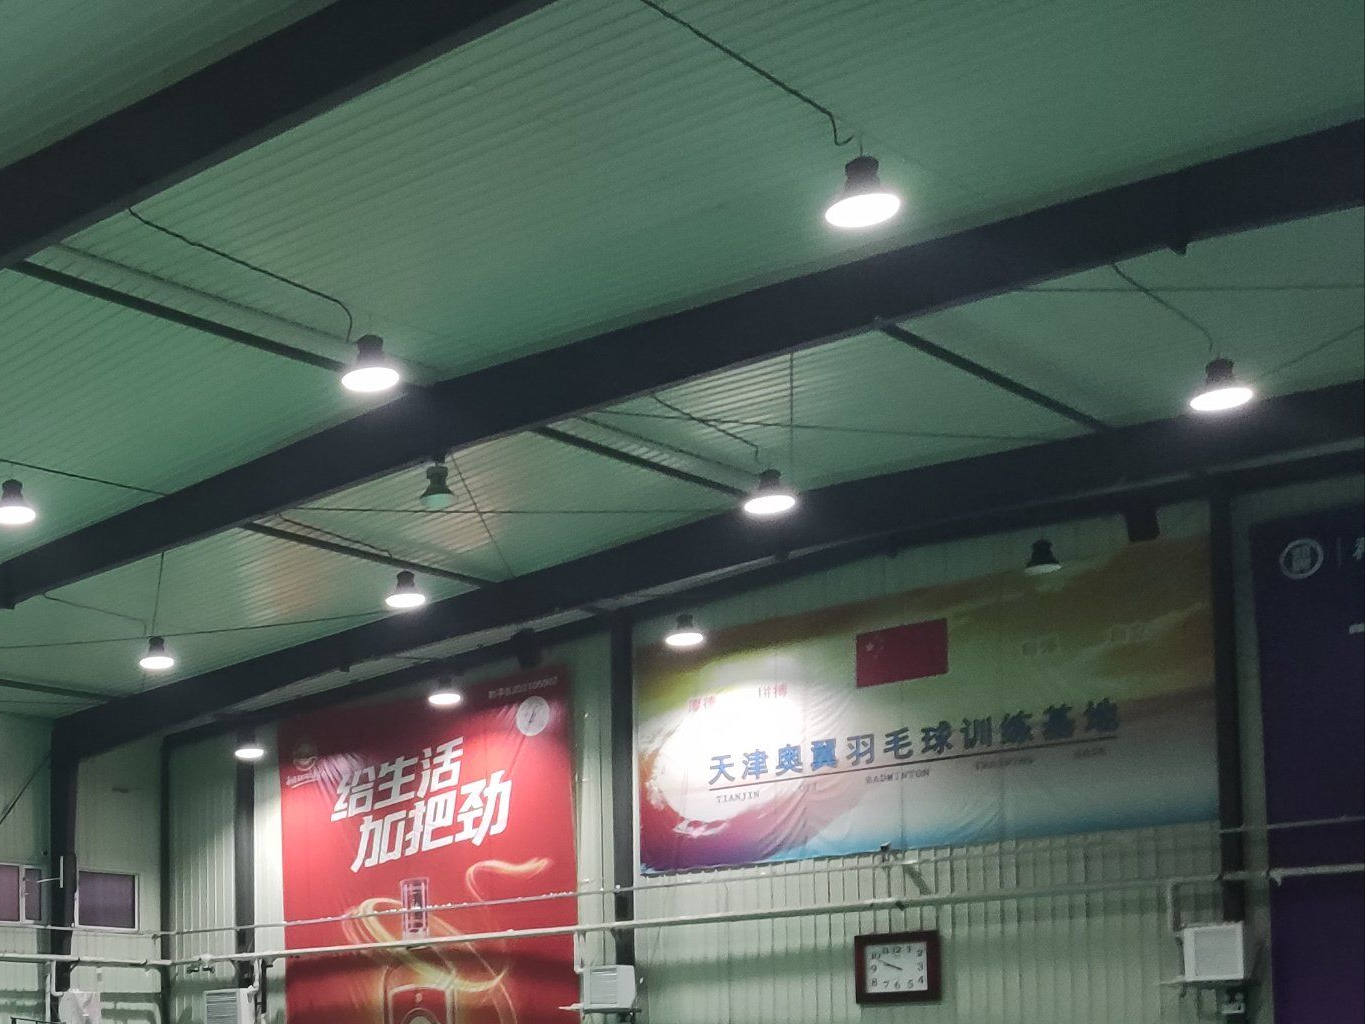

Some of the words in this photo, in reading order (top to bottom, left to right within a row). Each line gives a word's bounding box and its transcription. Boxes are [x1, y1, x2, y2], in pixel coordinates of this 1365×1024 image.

[330, 736, 464, 822] 给生活
[708, 697, 1120, 785] 天津奥翼羽毛球训练基地
[349, 769, 513, 873] 加把劲
[716, 790, 761, 804] TIANJIN
